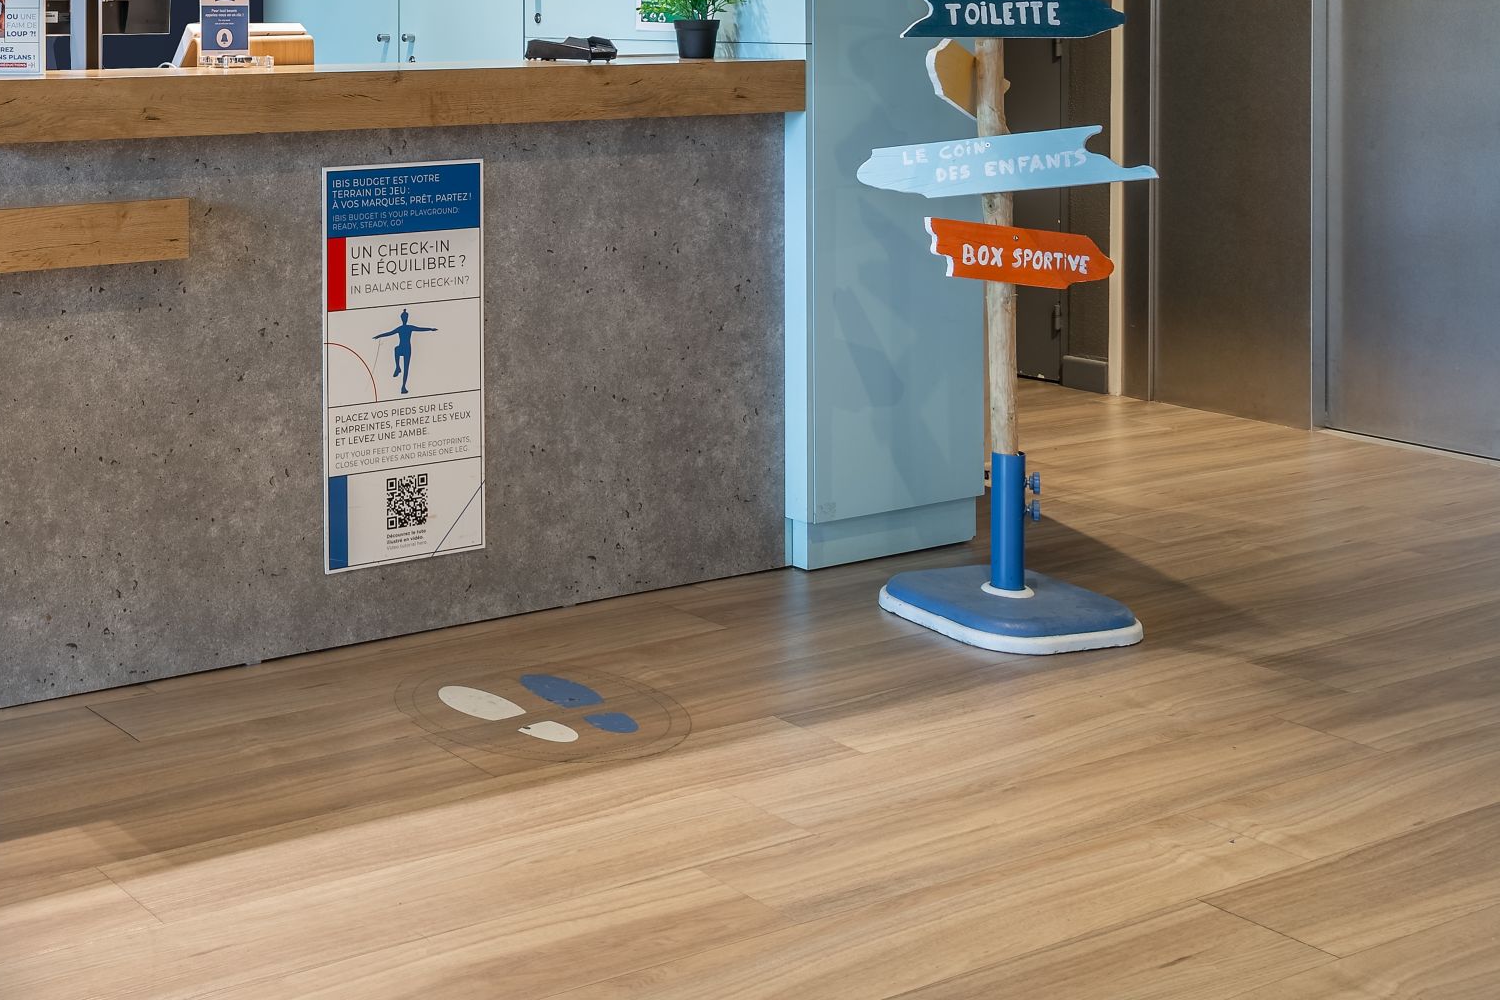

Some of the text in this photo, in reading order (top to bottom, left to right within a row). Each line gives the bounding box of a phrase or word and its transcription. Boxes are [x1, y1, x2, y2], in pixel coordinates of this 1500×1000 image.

[901, 146, 928, 165] LE
[935, 148, 1088, 183] DES ENFANTS
[332, 174, 440, 188] IBIS BUDGET EST VOTRE
[332, 188, 372, 199] TERRAIN
[374, 187, 387, 196] DE
[332, 199, 339, 209] À
[341, 200, 360, 209] VOS
[361, 197, 408, 208] MARQUES,
[410, 193, 434, 204] PRÊT,
[332, 214, 347, 222] IBIS
[348, 212, 378, 221] BUDGET
[388, 210, 409, 219] YOUR
[410, 207, 460, 217] PLAYGROUND:
[332, 219, 404, 231] READY, STEADY, GO!
[351, 239, 450, 260] UN CHECK-IN
[961, 243, 1004, 268] BOX
[351, 262, 371, 277] EN
[377, 255, 456, 275] ÉQUILIBRE
[350, 276, 470, 295] IN BALANCE CHECK-IN?
[335, 402, 454, 424] PLACEZ VOS PIEDS SUR LES
[335, 411, 472, 436] EMPREINTES, FERMEZ LES YEUX
[335, 437, 346, 447] ET
[348, 434, 375, 445] LEVEZ
[378, 431, 396, 441] UNE
[335, 436, 472, 460] PUT YOUR FEET ONTO THE FOOTPRINTS,
[335, 461, 358, 470] CLOSE
[360, 458, 380, 466] YOUR
[382, 455, 399, 463] EYES
[400, 453, 416, 461] AND
[417, 450, 437, 459] RAISE
[439, 447, 453, 455] ONE
